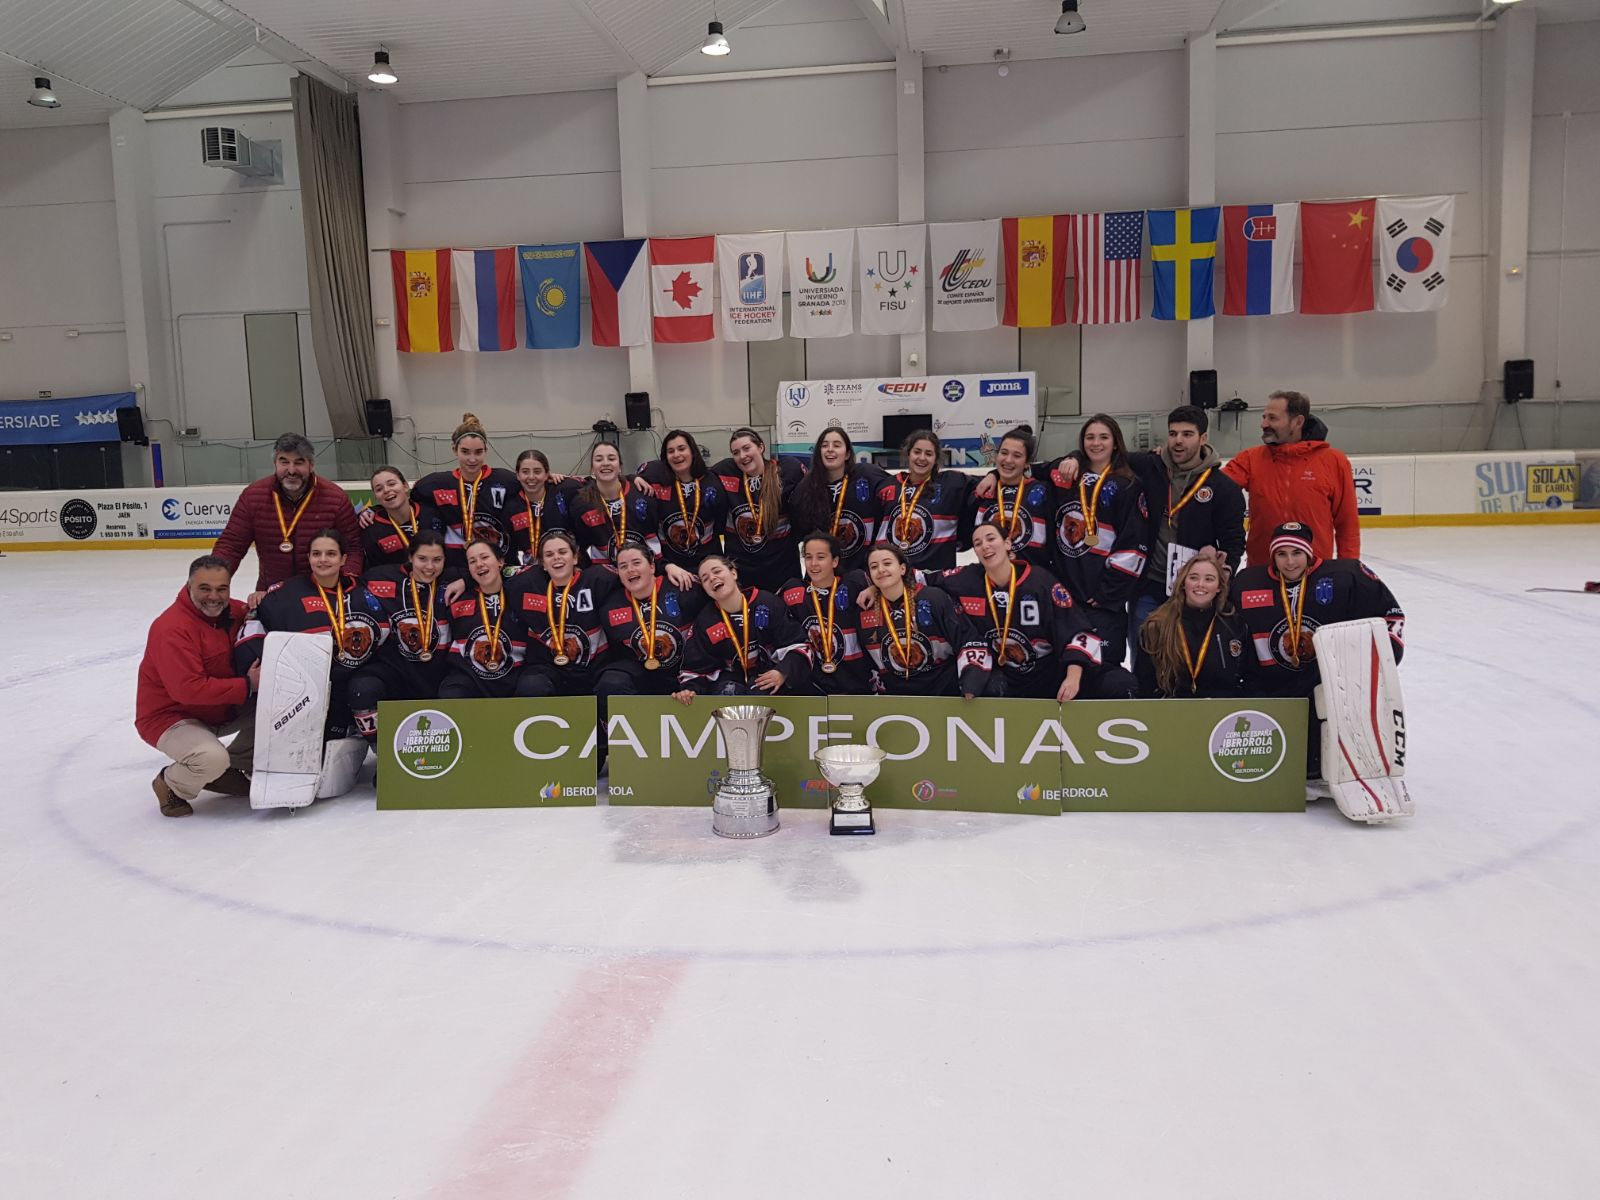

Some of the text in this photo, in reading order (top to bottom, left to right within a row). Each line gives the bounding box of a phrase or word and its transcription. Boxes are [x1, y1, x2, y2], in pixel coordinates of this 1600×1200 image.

[961, 278, 993, 289] CEDU
[743, 291, 763, 300] IIHF
[880, 301, 907, 311] FISU
[789, 387, 806, 407] ISU
[1352, 467, 1376, 475] IAL
[1532, 468, 1575, 484] SOLAN
[184, 501, 231, 516] Cuerva
[64, 515, 93, 524] PÓSITO
[117, 511, 131, 519] JAÉN
[1023, 604, 1035, 622] C
[359, 616, 374, 626] HIELO
[566, 627, 581, 636] HIELO
[657, 624, 674, 633] HIELO
[1009, 632, 1026, 644] HIELO
[431, 727, 451, 736] ESPAÑA
[1250, 728, 1272, 737] ESPAÑA
[406, 735, 451, 746] IBERDROLA
[513, 713, 1151, 766] CAMPEONAS
[1222, 737, 1273, 748] IBERDROLA
[1392, 709, 1406, 768] CCM
[402, 745, 430, 754] HOCKEY
[1218, 746, 1272, 756] HOCKEY HIELO
[1042, 787, 1109, 800] IBERDROLA
